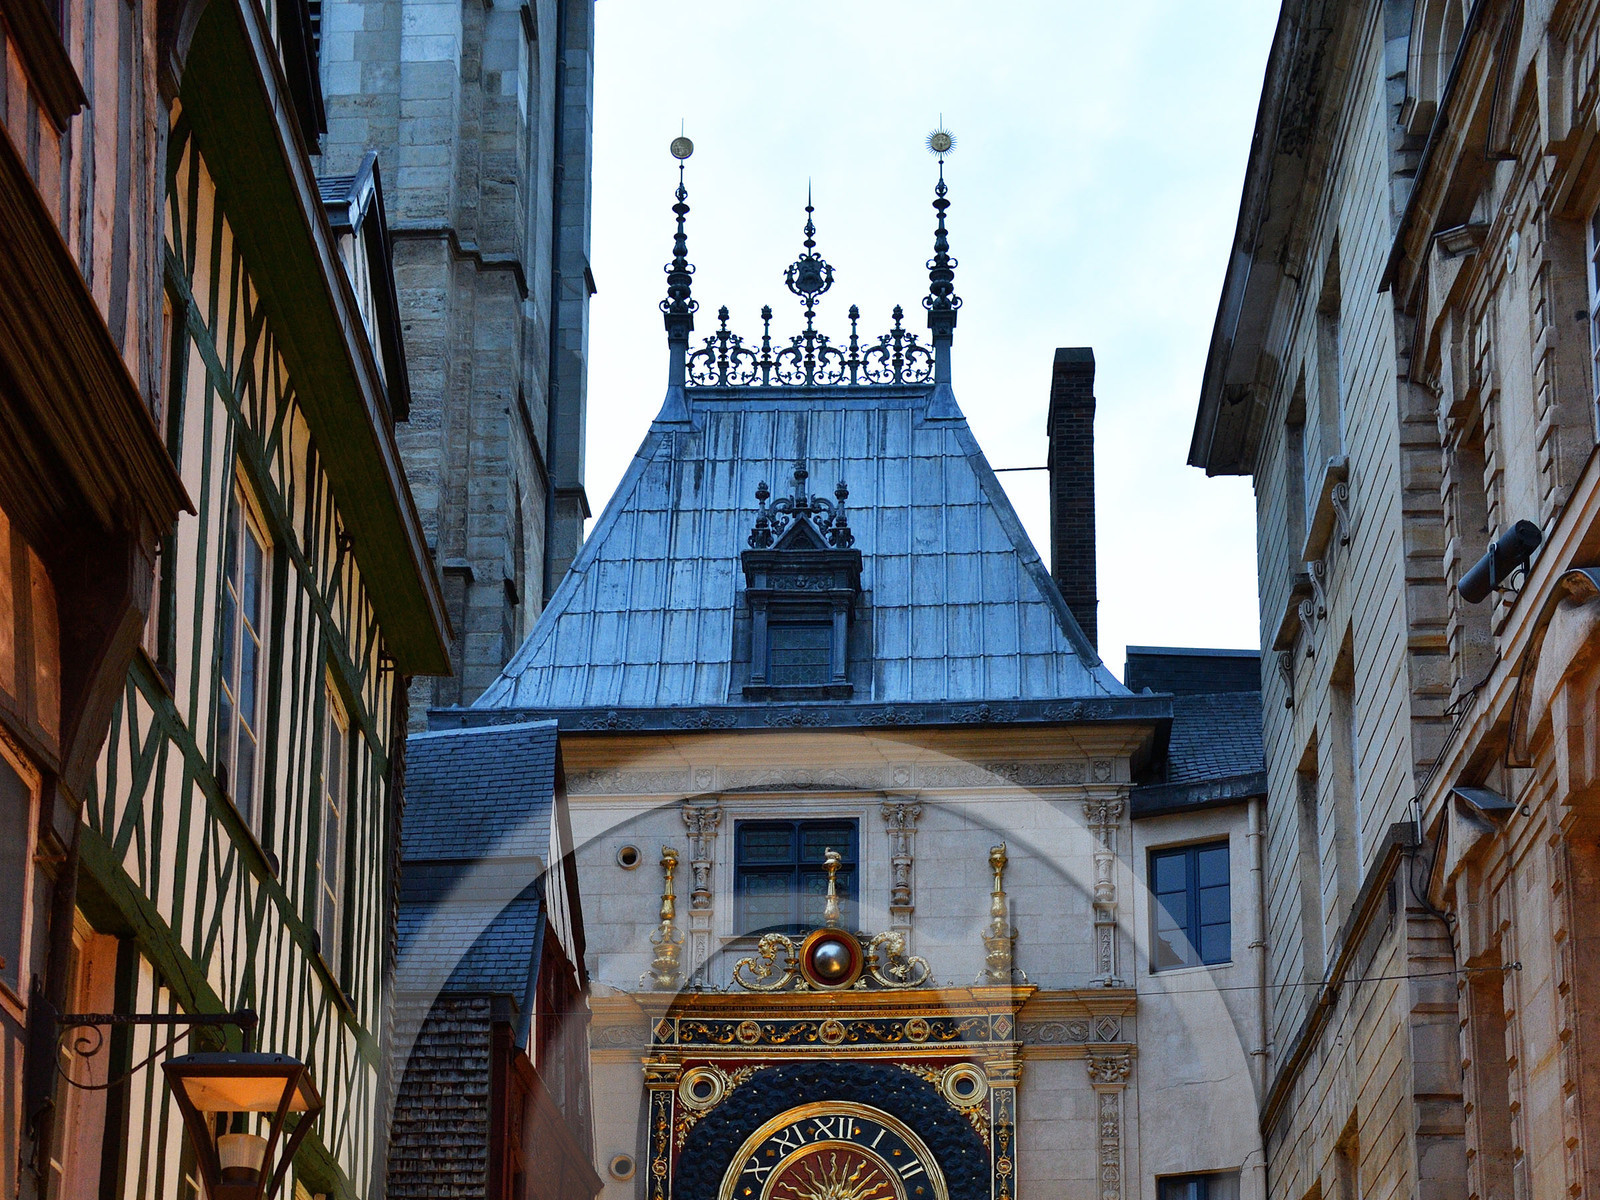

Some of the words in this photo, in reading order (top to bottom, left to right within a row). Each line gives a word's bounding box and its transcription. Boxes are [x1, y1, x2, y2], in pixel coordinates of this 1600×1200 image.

[813, 1117, 854, 1140] XII
[870, 1128, 887, 1149] I
[770, 1124, 807, 1158] XI
[742, 1156, 773, 1184] X
[898, 1159, 924, 1180] II
